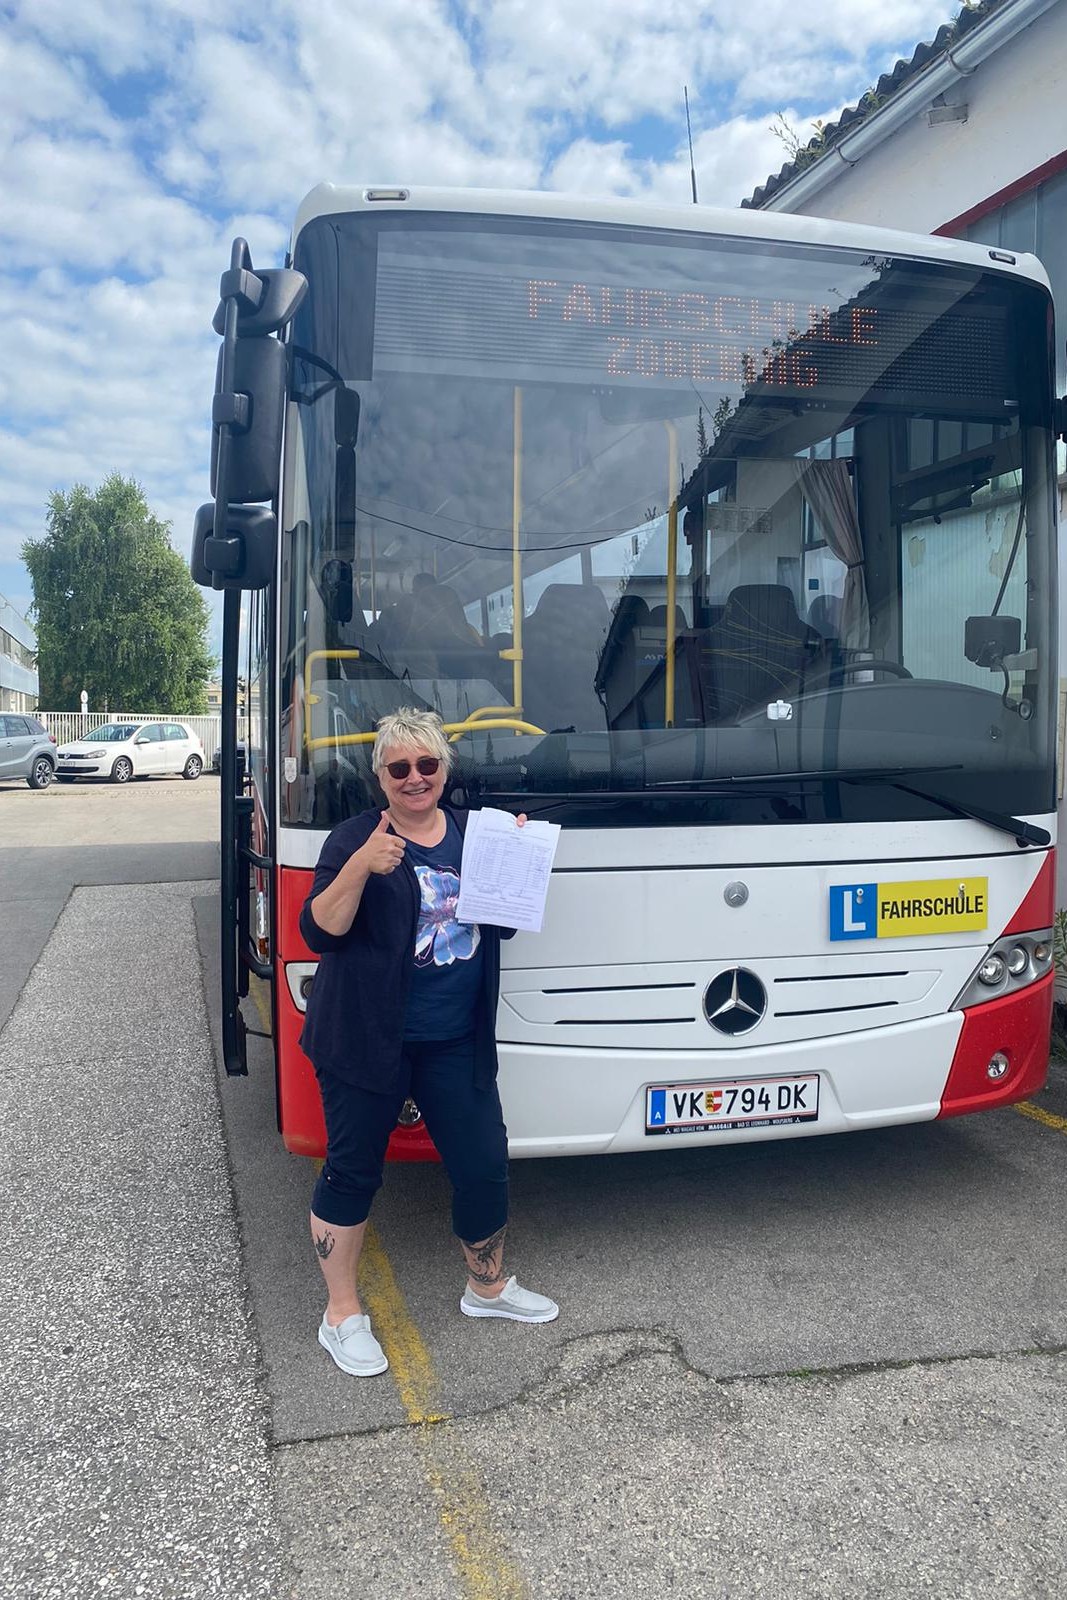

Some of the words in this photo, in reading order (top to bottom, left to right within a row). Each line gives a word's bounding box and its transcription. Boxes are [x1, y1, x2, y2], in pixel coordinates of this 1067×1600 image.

[528, 280, 878, 345] FAHRSCHULE
[843, 890, 866, 932] L
[881, 895, 984, 920] FAHRSCHULE
[673, 1092, 704, 1119] VK
[725, 1087, 771, 1115] 794
[778, 1083, 807, 1111] DK
